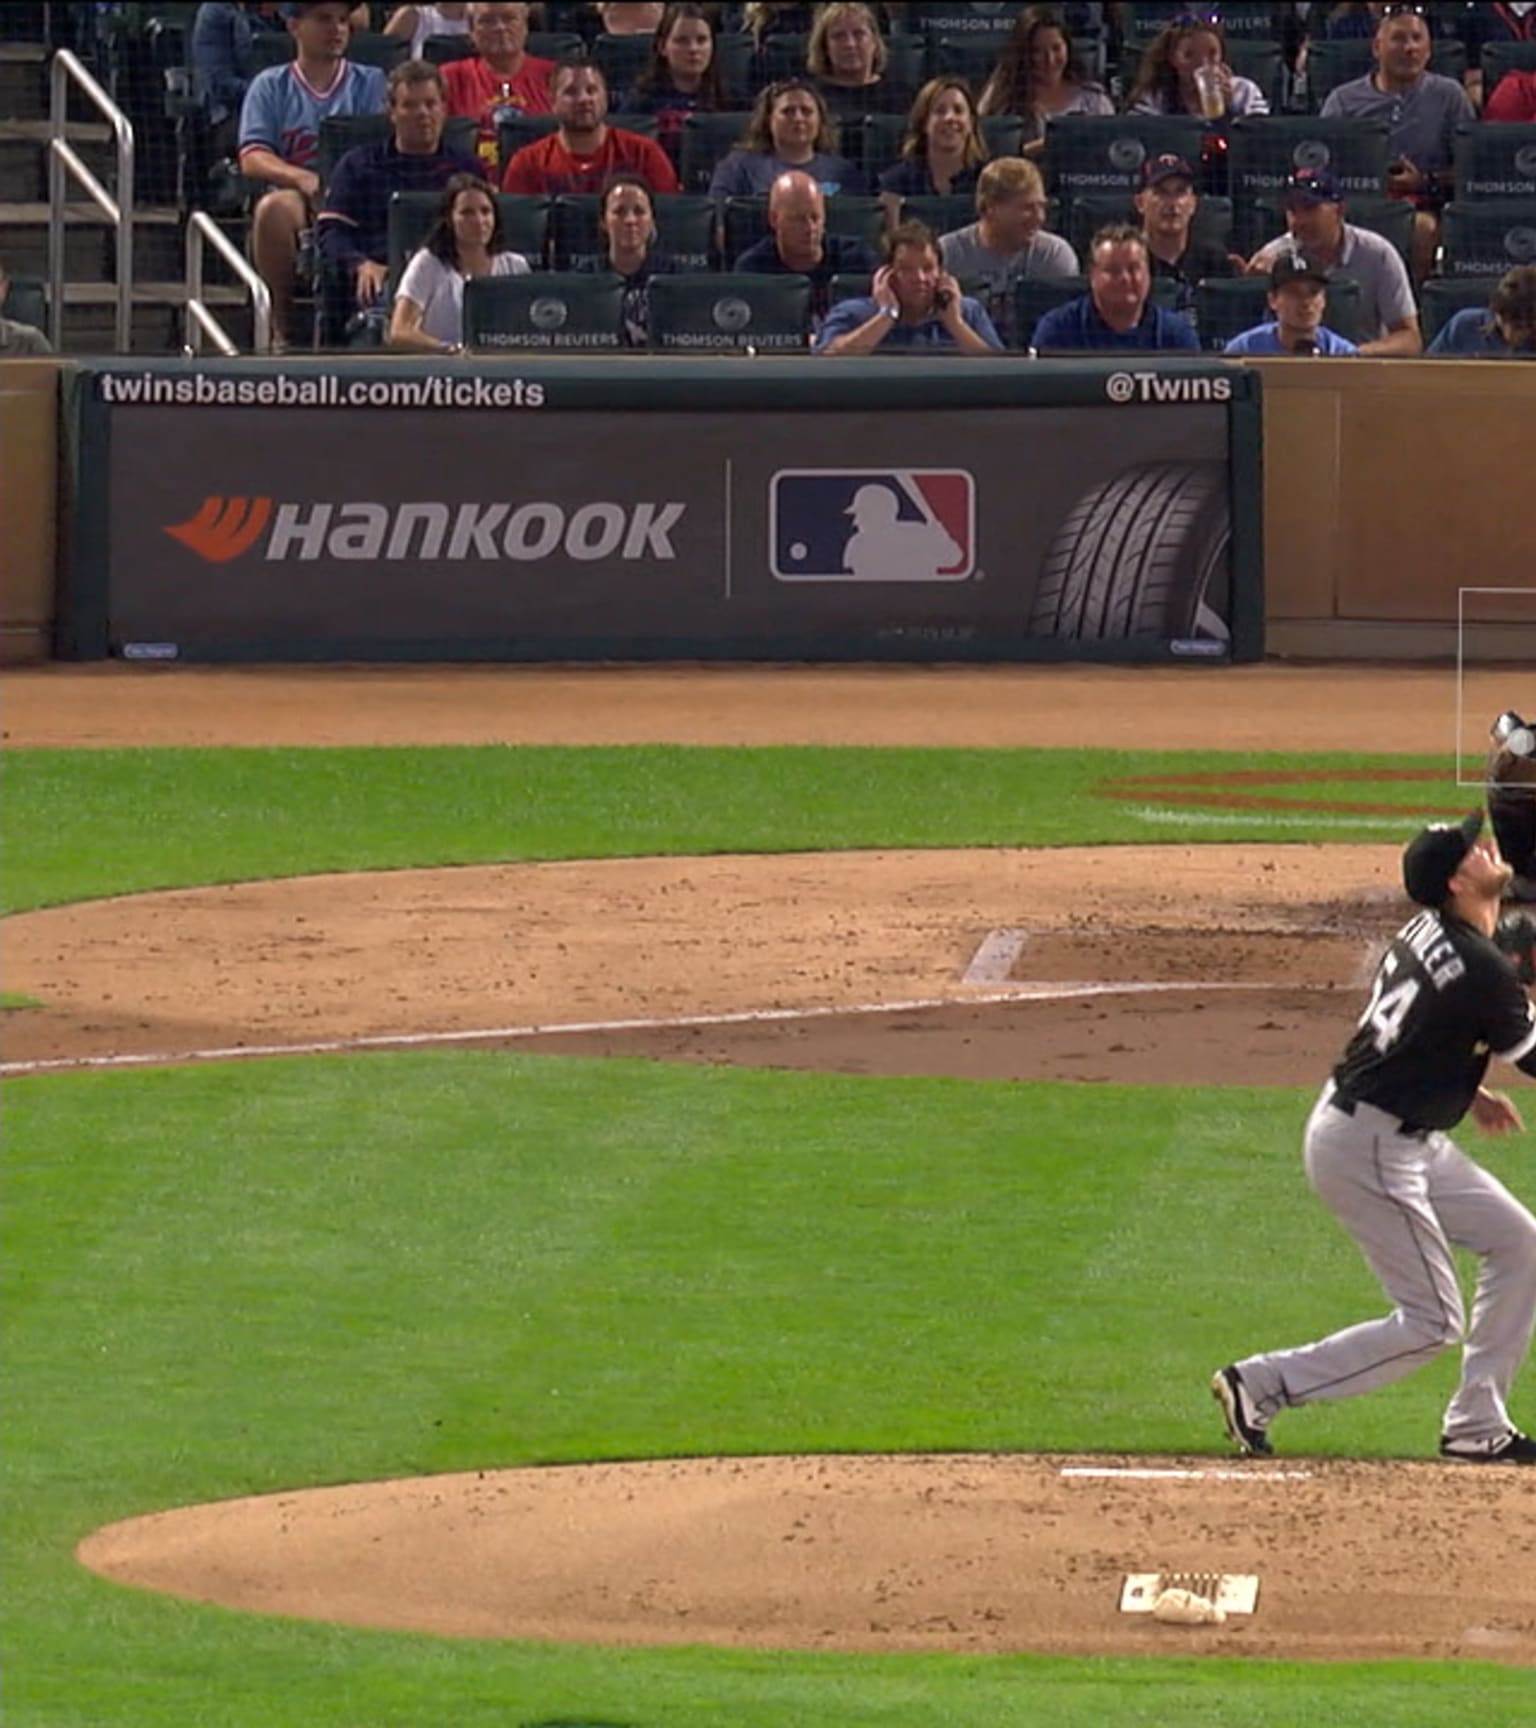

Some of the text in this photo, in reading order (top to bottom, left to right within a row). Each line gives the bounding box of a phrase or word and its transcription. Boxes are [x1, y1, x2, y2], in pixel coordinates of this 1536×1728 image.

[1059, 173, 1130, 187] THOMSON
[1466, 181, 1536, 193] THOMSON
[1453, 262, 1515, 275] THOMSO
[479, 332, 619, 347] THOMSON REUTERS
[662, 332, 802, 347] THOMSON REUTERS
[101, 373, 546, 408] twinsbaseball.com/tickets
[1106, 371, 1232, 403] @Twins
